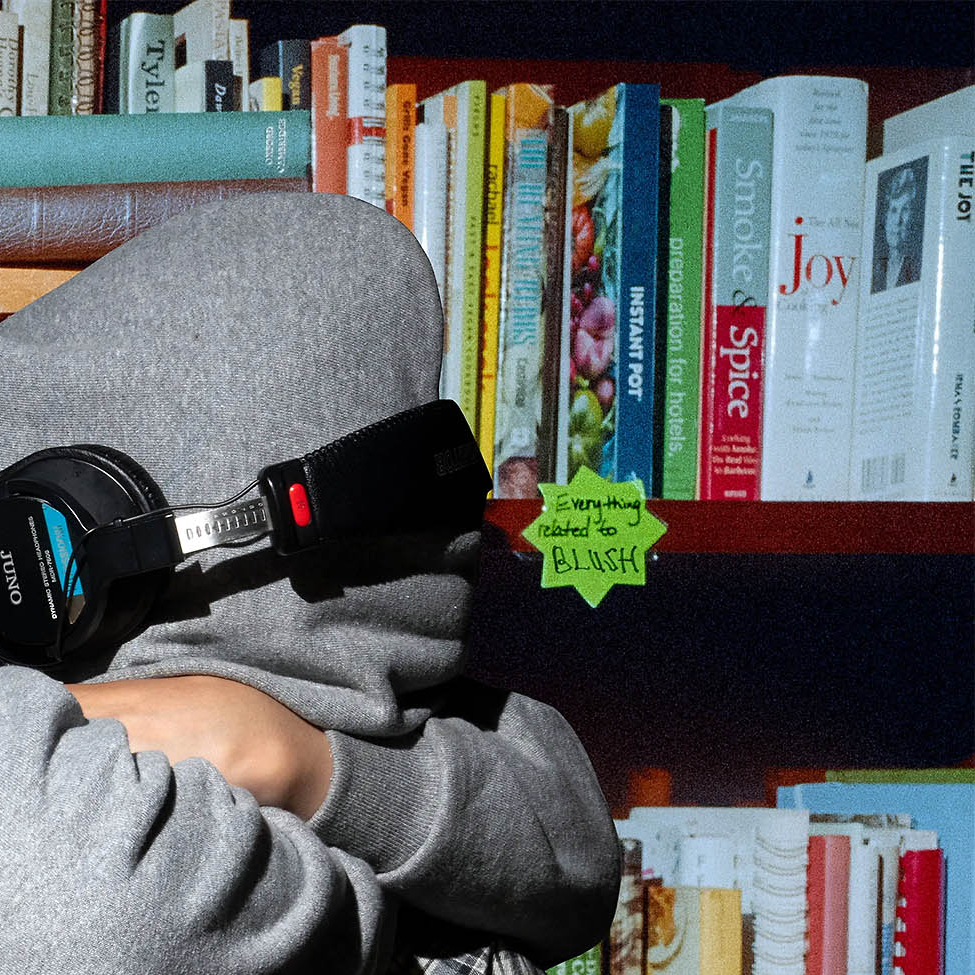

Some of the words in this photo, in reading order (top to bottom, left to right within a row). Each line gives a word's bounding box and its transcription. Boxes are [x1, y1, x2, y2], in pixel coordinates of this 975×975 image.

[288, 63, 303, 105] Vegan
[265, 126, 274, 166] OXFORD
[402, 134, 411, 166] Gone
[401, 169, 411, 207] Vegan
[960, 151, 975, 192] THE
[487, 164, 499, 225] rachael
[957, 194, 973, 223] JOY
[733, 158, 763, 282] Smoke
[668, 237, 685, 352] preparation
[731, 289, 757, 316] &
[628, 285, 645, 360] INSTANT
[628, 361, 645, 402] POT
[669, 359, 687, 385] for
[720, 325, 759, 419] Spice
[538, 516, 591, 538] related
[596, 519, 618, 537] to
[556, 492, 642, 527] Everything
[27, 515, 43, 561] HEADPHONES
[0, 549, 22, 605] JUNO
[38, 561, 51, 588] STEREO
[552, 545, 639, 574] BLUSH
[45, 588, 58, 620] DYNAMIC
